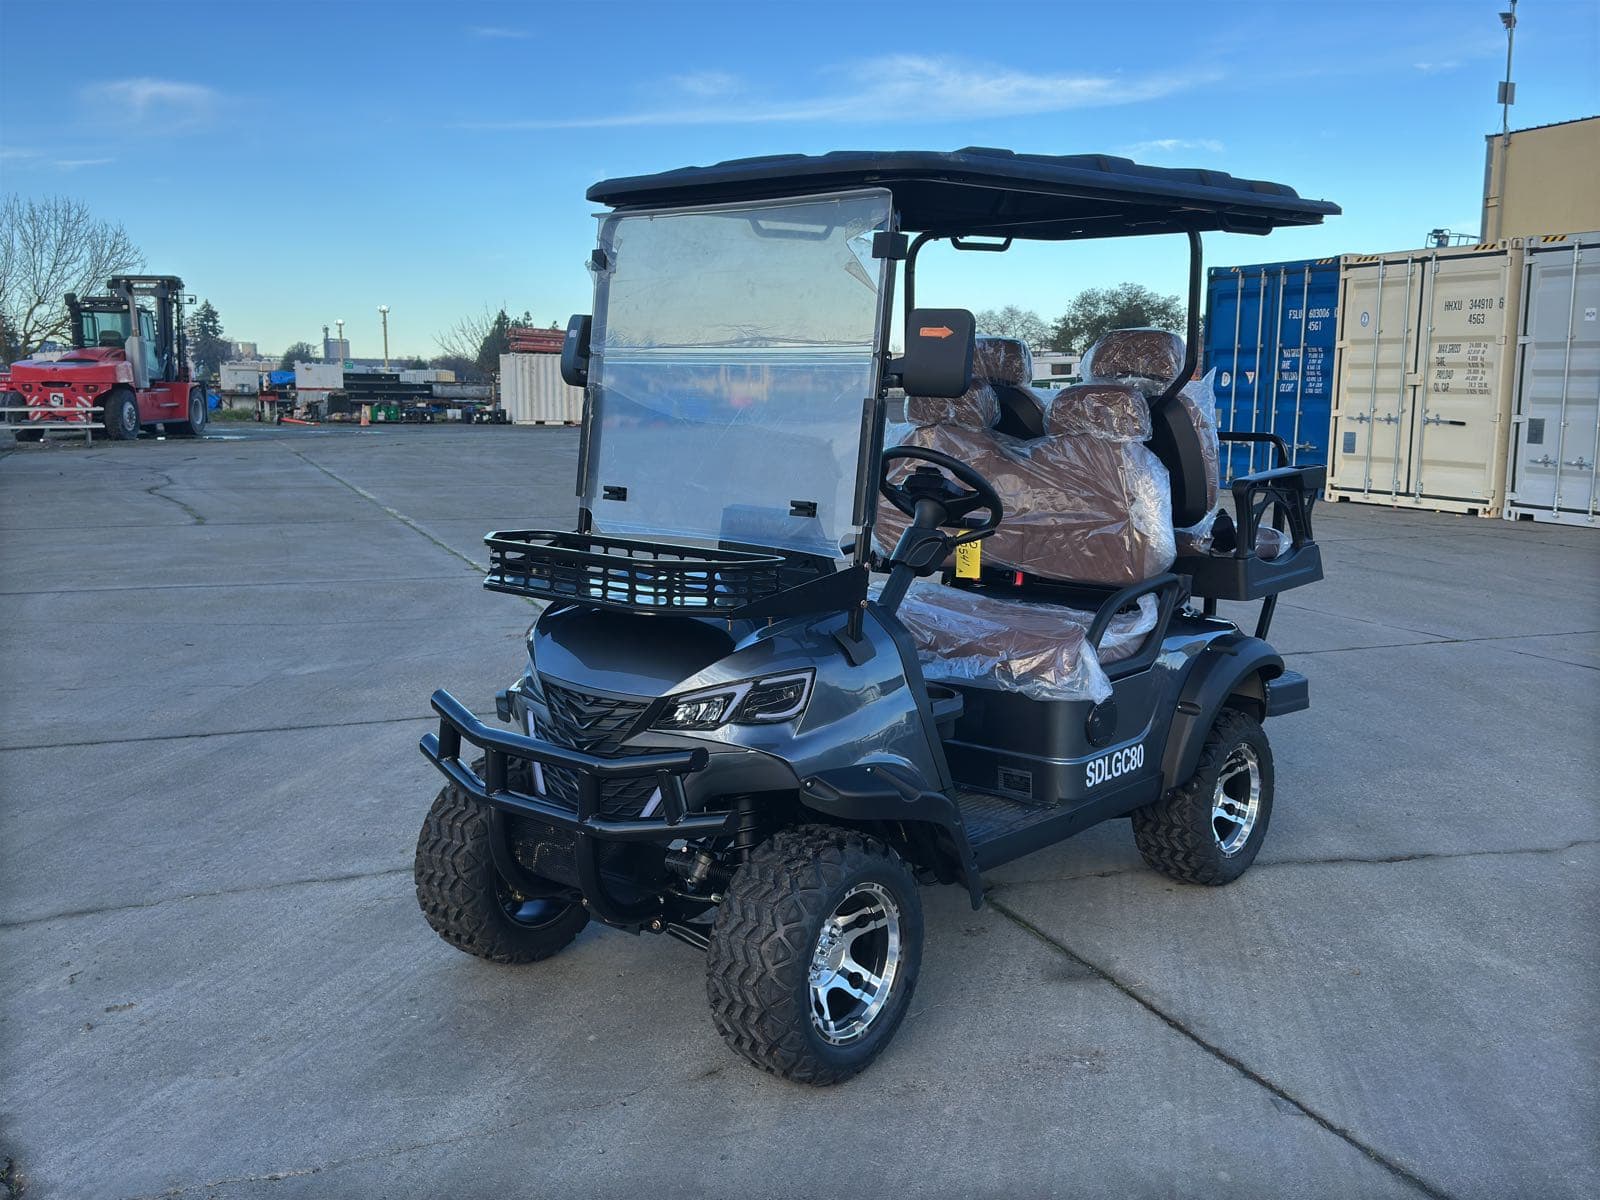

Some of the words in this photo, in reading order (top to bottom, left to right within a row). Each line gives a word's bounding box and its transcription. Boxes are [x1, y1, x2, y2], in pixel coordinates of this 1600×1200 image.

[1444, 300, 1462, 311] HHXU
[1469, 298, 1493, 310] 344910
[1468, 313, 1485, 325] 45G3
[1308, 321, 1322, 331] 45G1
[1086, 744, 1144, 788] SDLGC80
